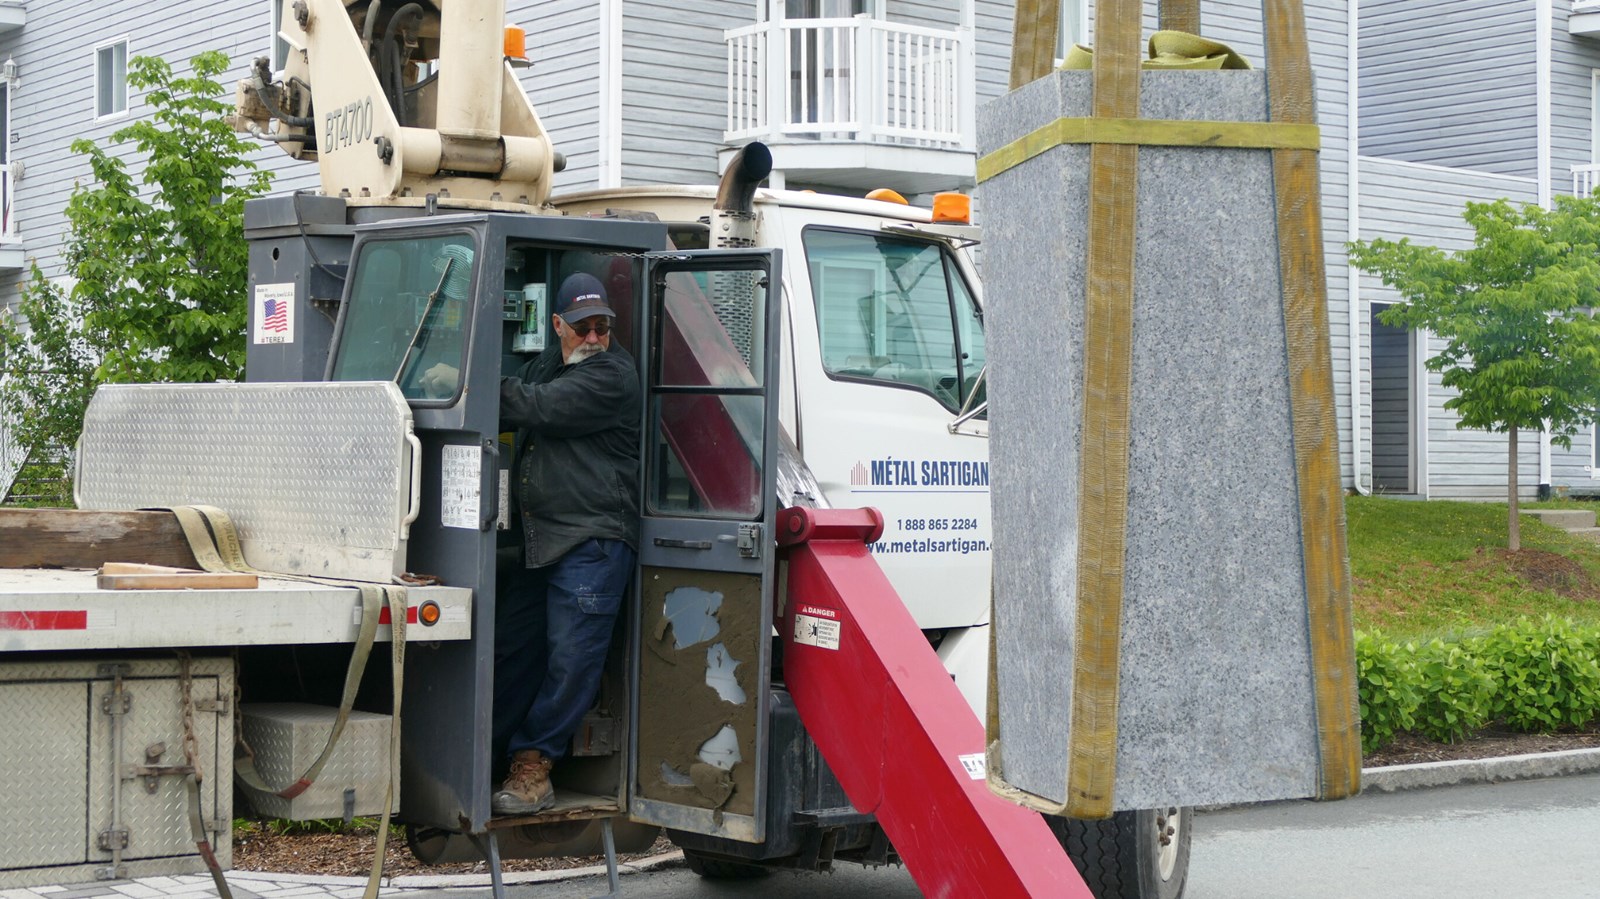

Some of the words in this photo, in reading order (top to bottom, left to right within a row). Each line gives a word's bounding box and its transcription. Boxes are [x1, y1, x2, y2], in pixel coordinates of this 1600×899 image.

[325, 95, 373, 154] BT4700
[871, 456, 918, 486] MÉTAL
[921, 460, 990, 486] SARTIGAN
[897, 519, 902, 531] 1
[905, 519, 926, 531] 888
[928, 519, 948, 531] 865
[951, 518, 978, 530] 2284
[808, 606, 836, 618] DANGER
